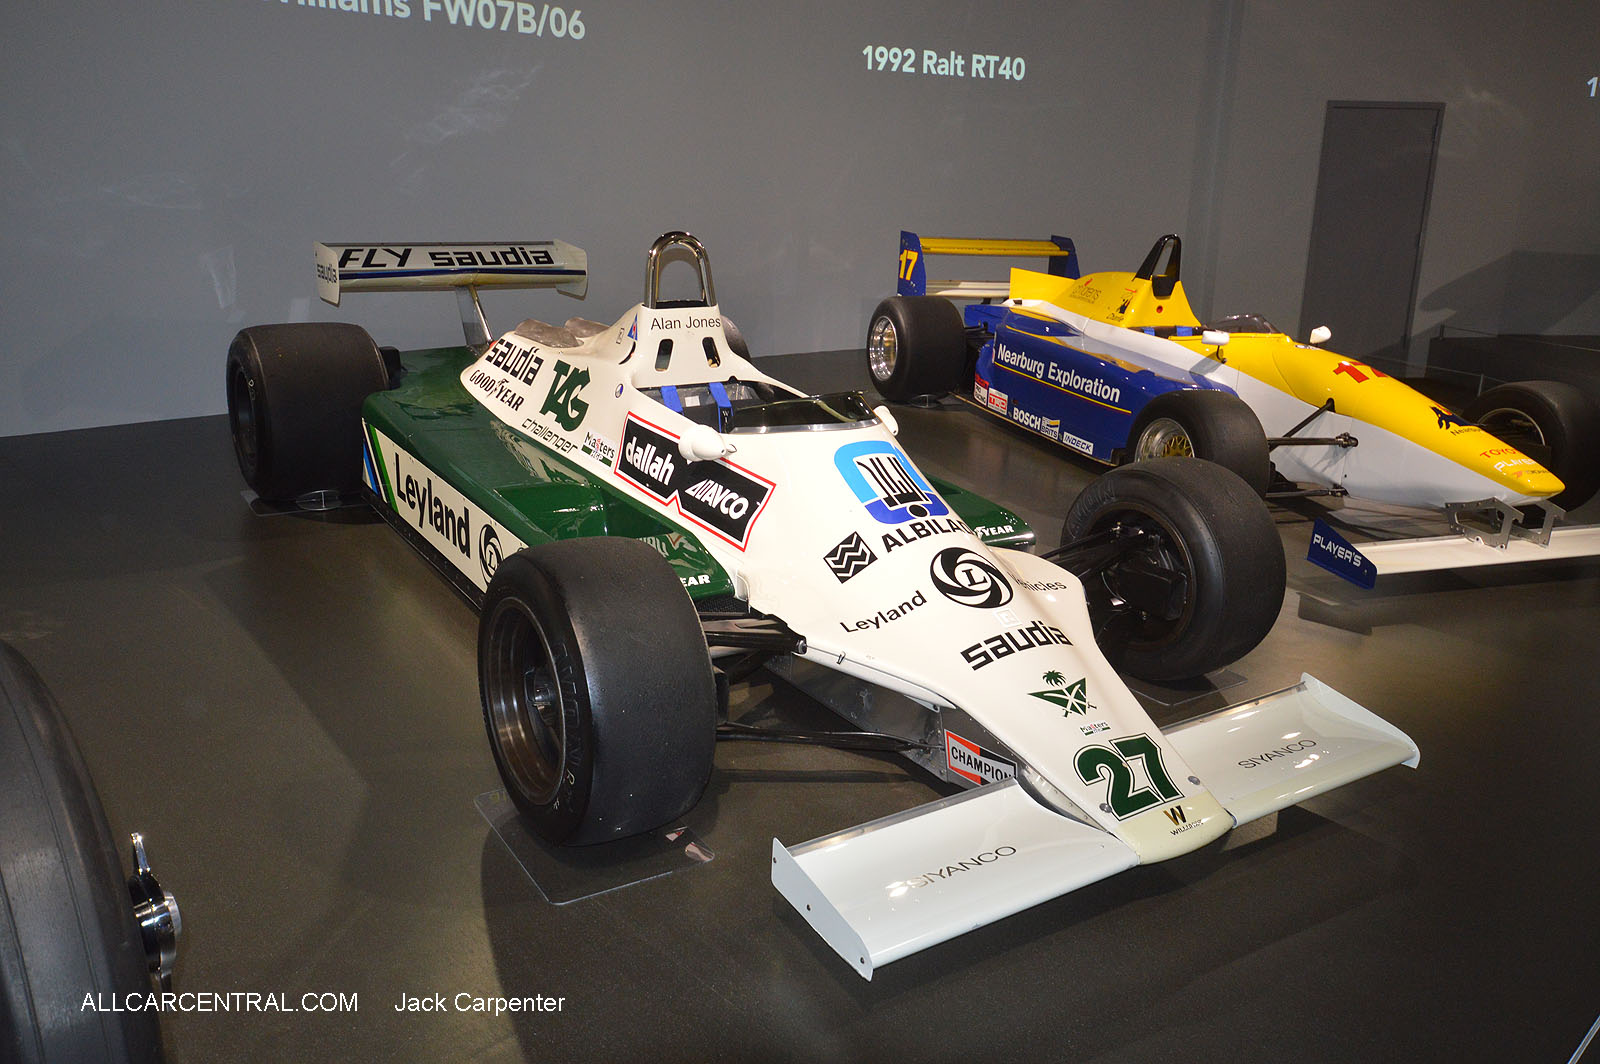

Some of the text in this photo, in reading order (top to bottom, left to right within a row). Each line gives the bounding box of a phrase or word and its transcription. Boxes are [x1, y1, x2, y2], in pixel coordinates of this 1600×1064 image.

[862, 45, 1026, 81] 1992 Ralt RT40
[338, 247, 554, 268] FLY saudia
[899, 249, 919, 281] 17
[651, 316, 722, 330] Alan Jones
[484, 338, 544, 386] saudia
[998, 344, 1121, 403] Nearburg Exploration
[538, 360, 591, 430] TAG
[1013, 407, 1041, 431] BOSCH
[625, 437, 675, 486] dallah
[1064, 433, 1093, 455] INDECK
[394, 452, 471, 560] Leyland
[1312, 533, 1362, 567] PLAYER'S
[840, 590, 927, 634] Leyland
[960, 620, 1074, 671] saudia
[951, 745, 1015, 781] CHAMPION
[1237, 739, 1320, 770] SIYANCO
[1074, 733, 1184, 822] 27
[909, 846, 1018, 890] SIYANCO
